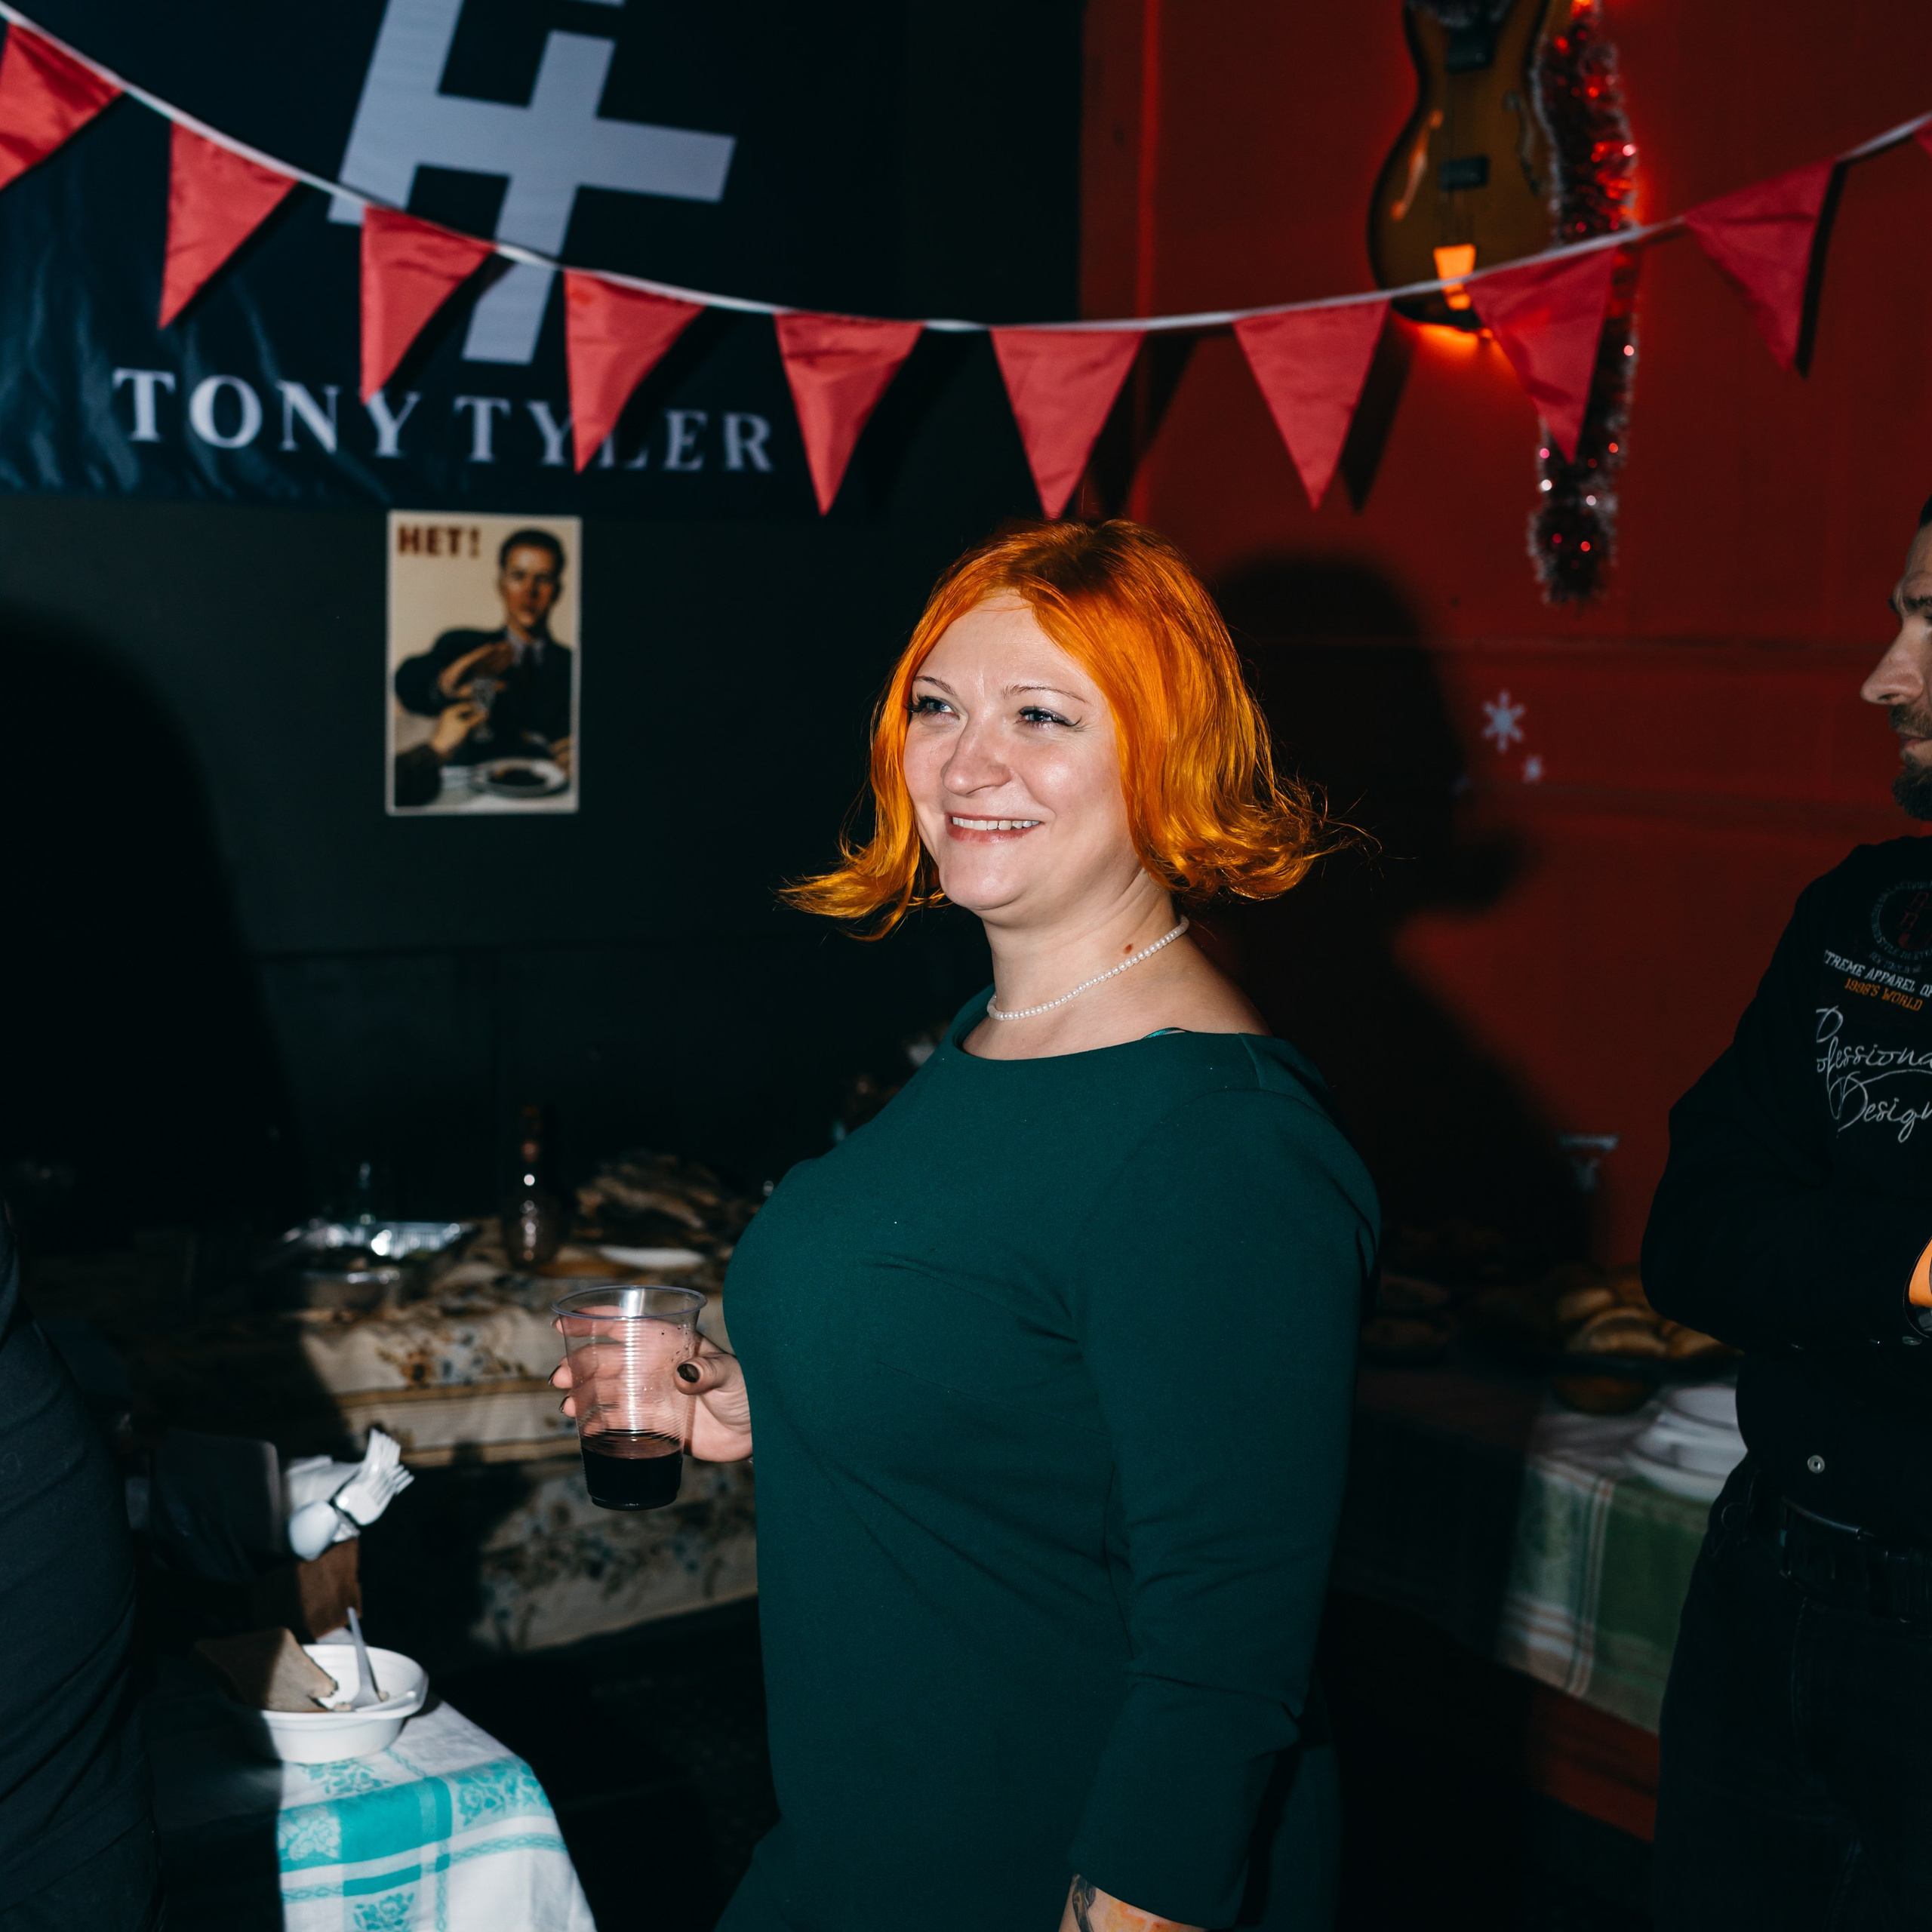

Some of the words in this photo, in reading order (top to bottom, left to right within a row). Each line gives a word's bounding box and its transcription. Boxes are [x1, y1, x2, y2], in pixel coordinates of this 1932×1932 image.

[111, 367, 421, 458] TONY
[398, 526, 480, 558] НЕТ!
[1824, 949, 1866, 977] TREME
[1864, 968, 1916, 992] APPAREL
[1844, 977, 1881, 997] 1998'S
[1881, 987, 1924, 1011] WORLD
